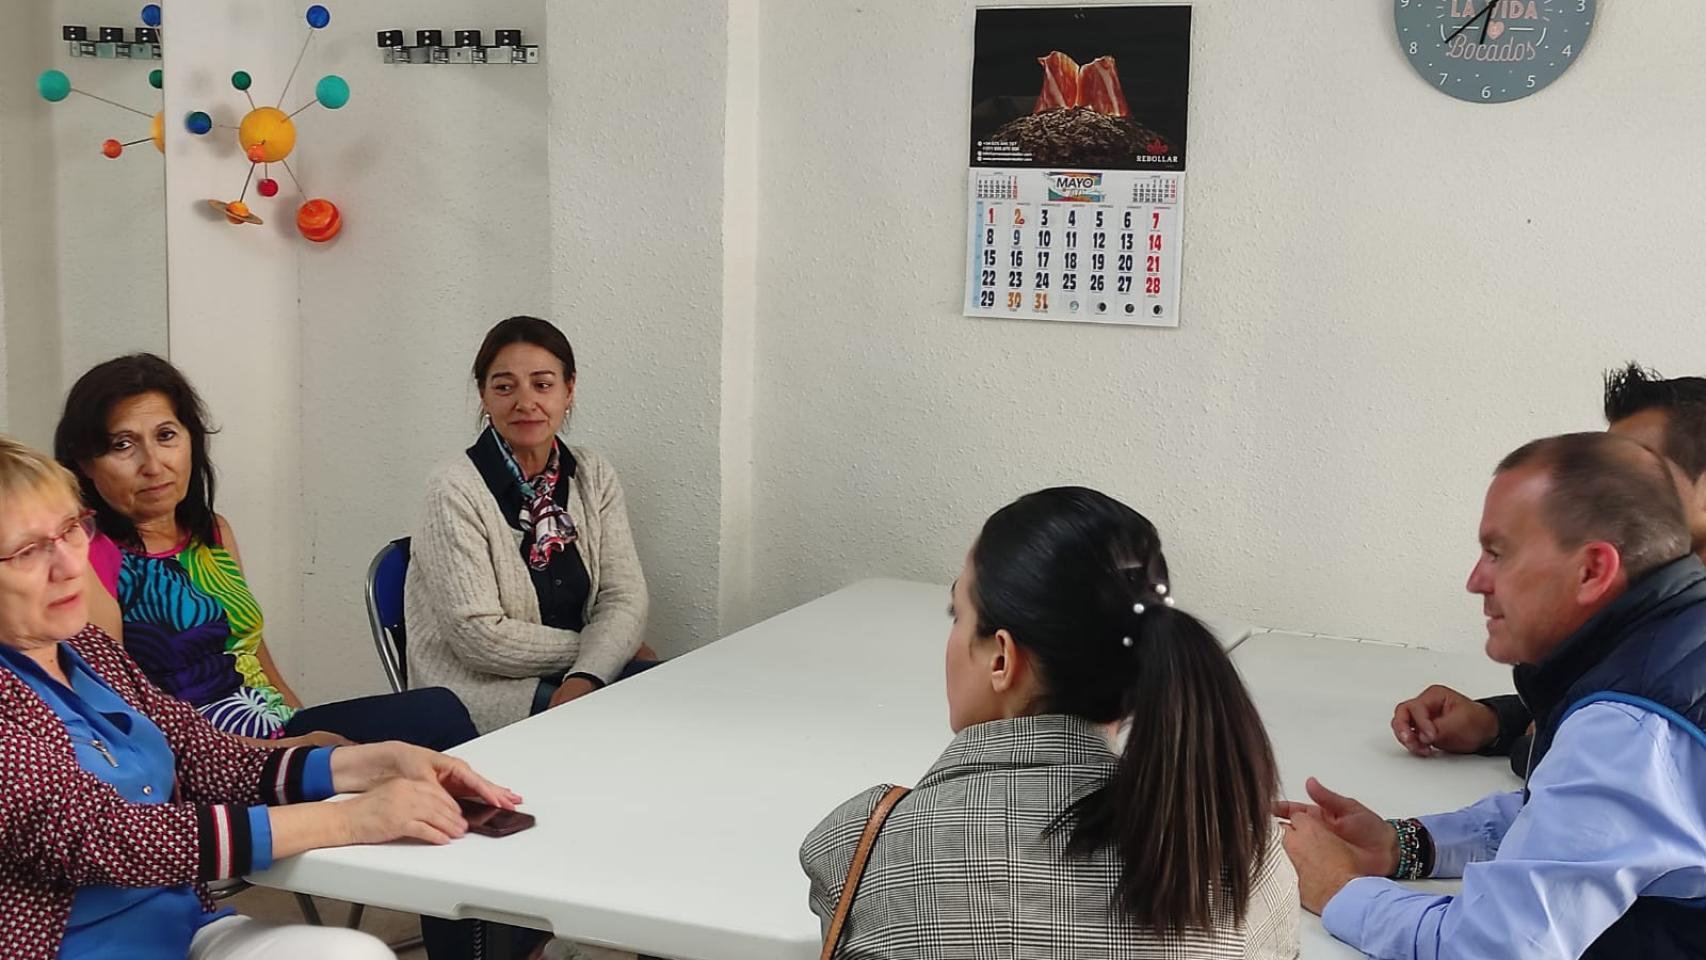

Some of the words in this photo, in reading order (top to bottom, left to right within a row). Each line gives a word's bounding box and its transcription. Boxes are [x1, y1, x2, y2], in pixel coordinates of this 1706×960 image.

[1451, 0, 1476, 17] LA
[1576, 0, 1585, 12] 3
[1409, 42, 1418, 54] 8
[1445, 33, 1536, 61] Bocados
[1562, 45, 1572, 57] 4
[1439, 73, 1448, 85] 7
[1527, 75, 1536, 88] 5
[1482, 86, 1491, 98] 6
[1136, 155, 1178, 163] REBOLLAR
[1056, 177, 1093, 188] MAYO
[988, 208, 994, 224] 1
[1014, 208, 1023, 224] 2
[1041, 209, 1048, 226] 3
[1068, 210, 1076, 226] 4
[1096, 211, 1103, 227] 5
[1124, 212, 1131, 228] 6
[1152, 213, 1159, 229] 7
[987, 228, 994, 244] 8
[1013, 229, 1020, 245] 9
[1038, 230, 1051, 246] 10
[1066, 231, 1077, 247] 11
[1093, 232, 1105, 249] 12
[1121, 233, 1133, 250] 13
[1149, 234, 1162, 251] 14
[984, 250, 996, 266] 15
[1011, 251, 1023, 267] 16
[1038, 252, 1049, 268] 17
[1064, 253, 1077, 269] 18
[1092, 254, 1104, 270] 19
[1118, 255, 1133, 271] 20
[1147, 256, 1160, 272] 21
[982, 270, 996, 286] 22
[1009, 271, 1022, 287] 23
[1035, 272, 1049, 288] 24
[1063, 274, 1077, 290] 25
[1090, 275, 1104, 291] 26
[1118, 276, 1132, 292] 27
[1146, 277, 1160, 294] 28
[981, 291, 995, 306] 29
[1008, 292, 1021, 308] 30
[1034, 293, 1048, 309] 31
